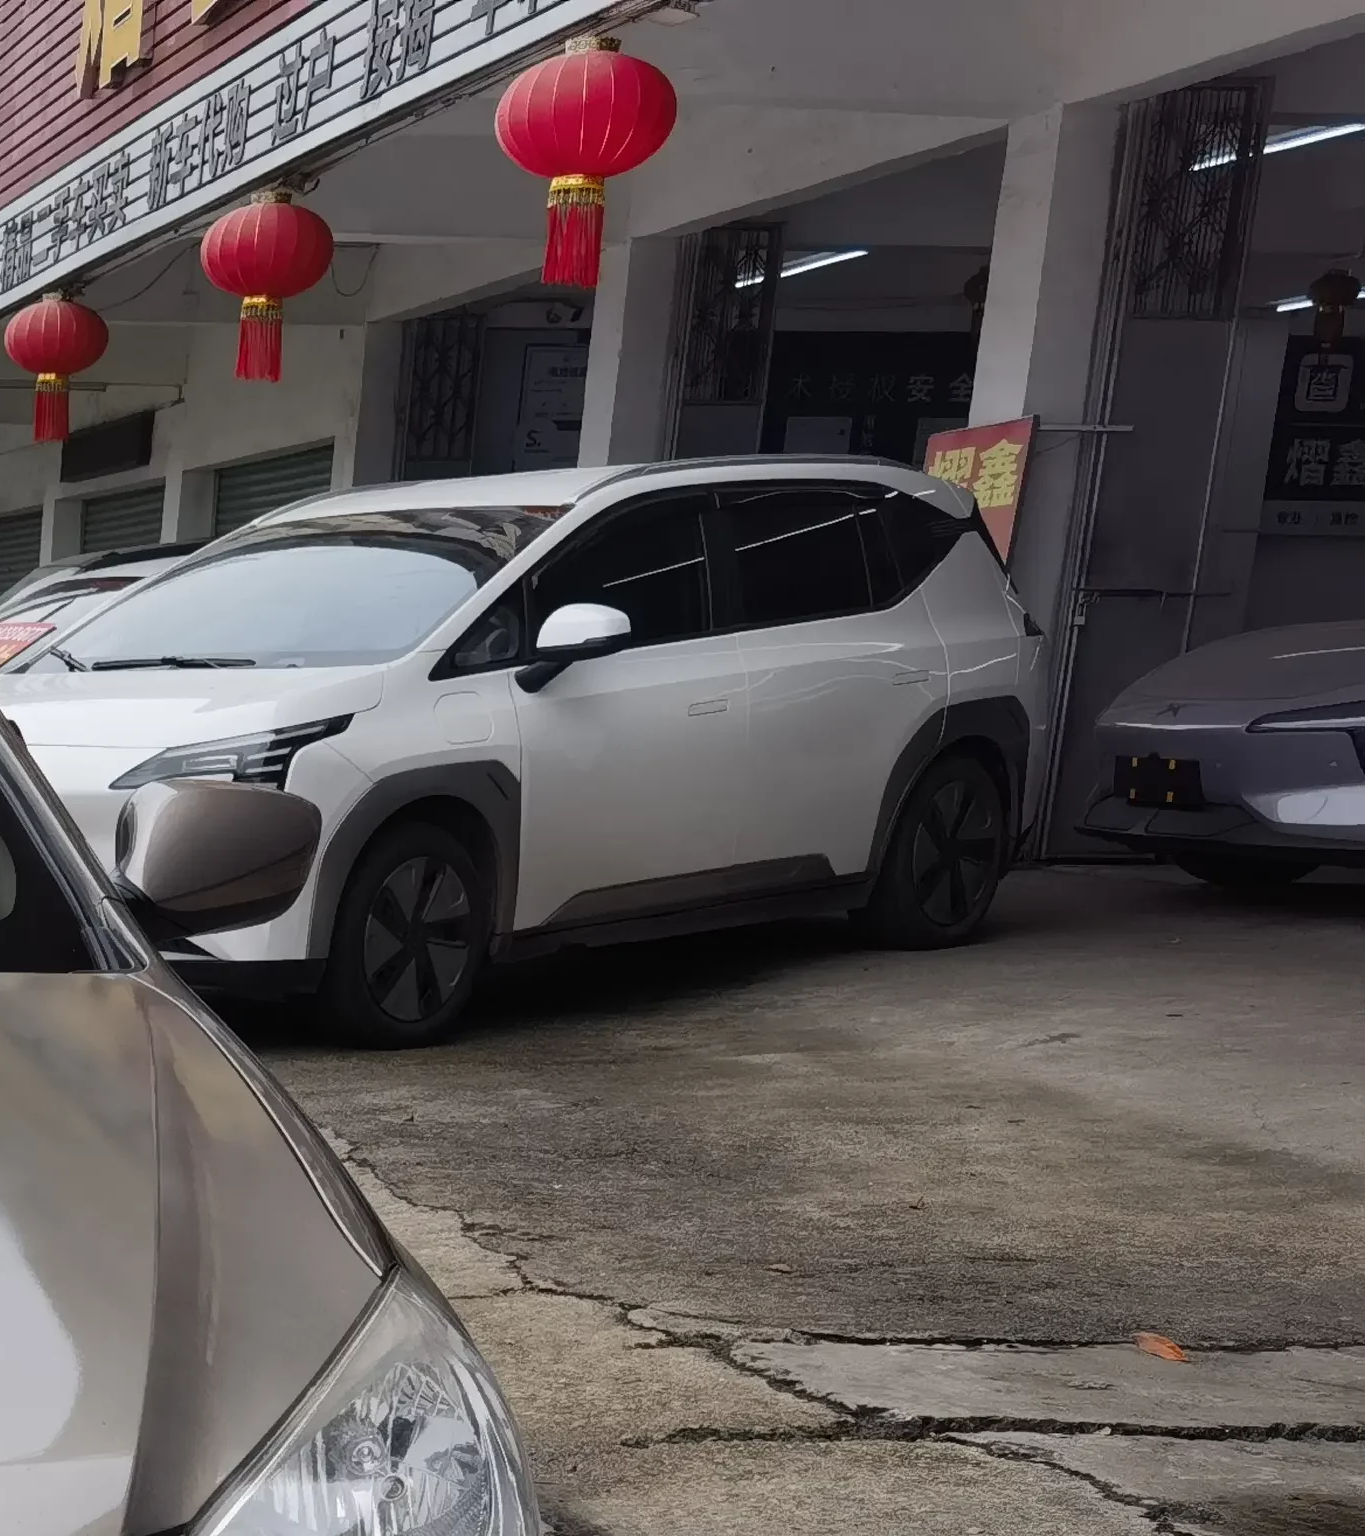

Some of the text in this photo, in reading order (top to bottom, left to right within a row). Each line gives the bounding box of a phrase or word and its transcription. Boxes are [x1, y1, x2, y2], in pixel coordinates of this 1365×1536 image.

[0, 150, 131, 294] 精品二手车买卖
[147, 78, 252, 211] 新车代购
[271, 27, 336, 146] 过户
